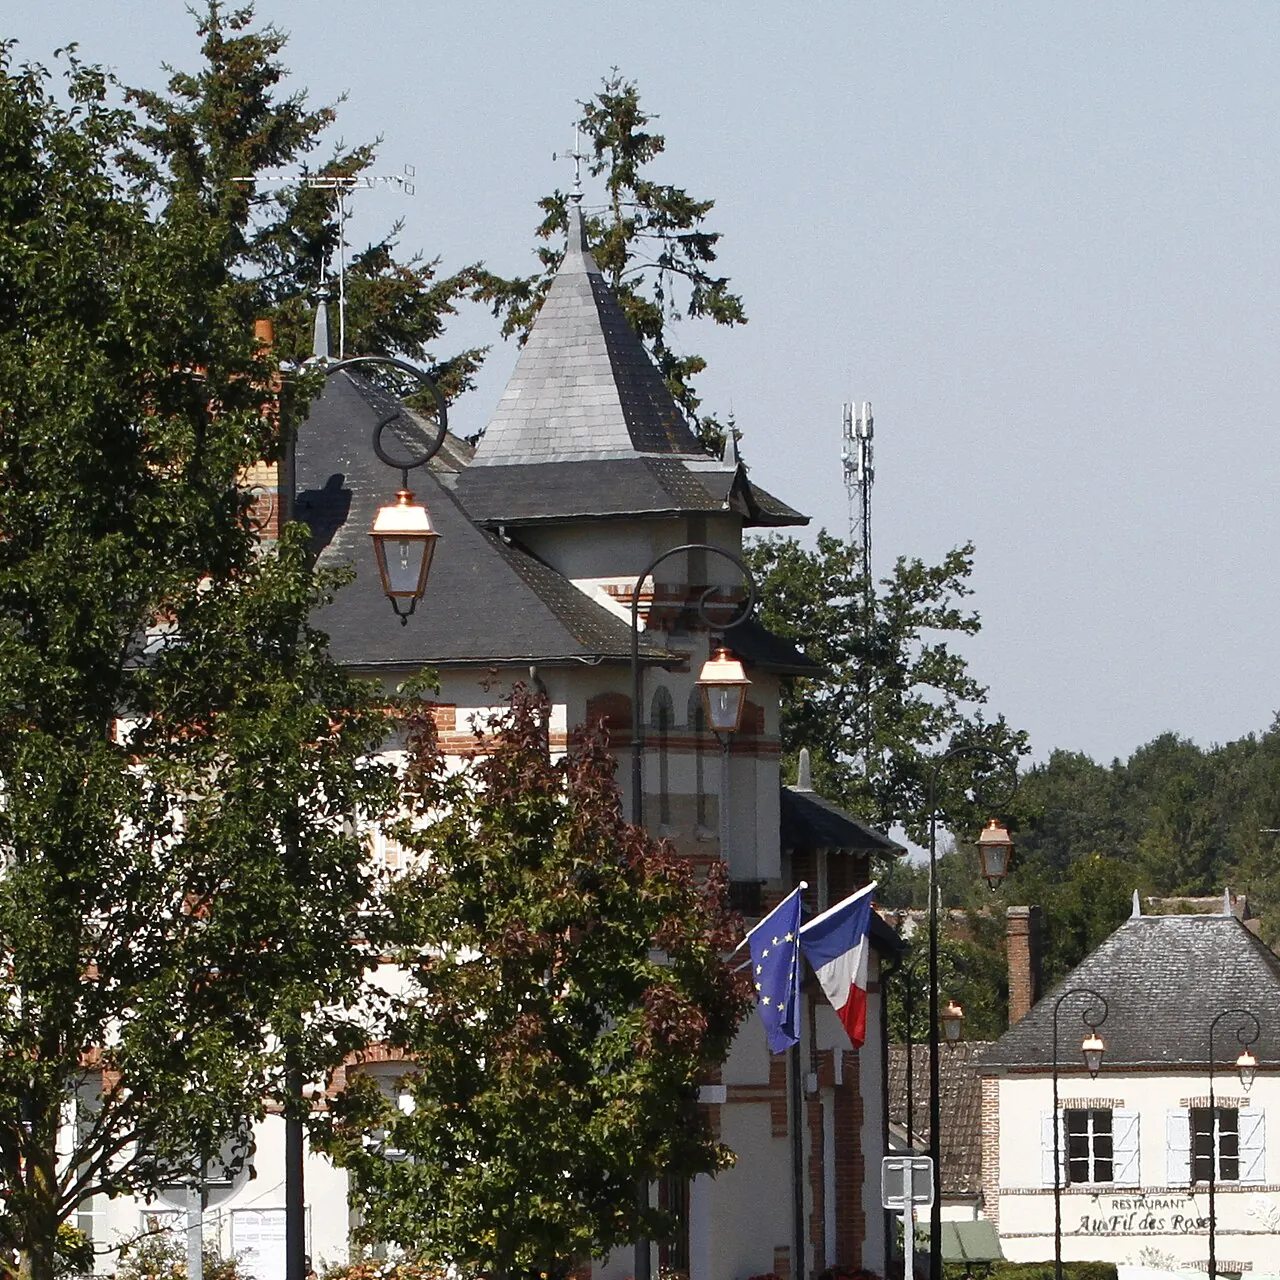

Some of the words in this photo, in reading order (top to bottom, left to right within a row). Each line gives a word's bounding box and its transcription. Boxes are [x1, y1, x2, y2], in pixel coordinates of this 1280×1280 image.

[1112, 1199, 1186, 1210] RESTAURANT
[1074, 1215, 1104, 1233] Au
[1108, 1212, 1137, 1231] Fil
[1139, 1212, 1166, 1230] des
